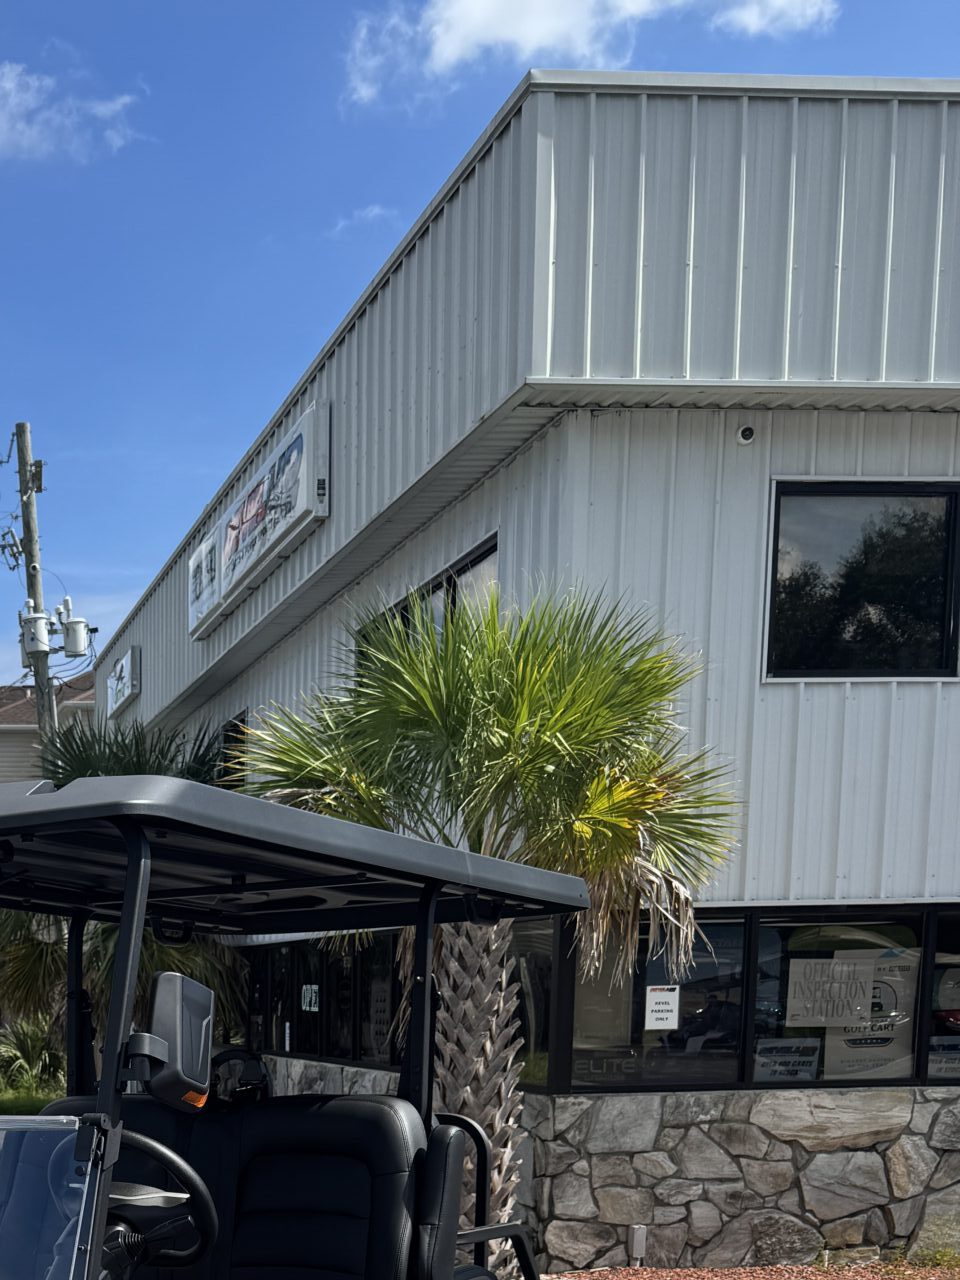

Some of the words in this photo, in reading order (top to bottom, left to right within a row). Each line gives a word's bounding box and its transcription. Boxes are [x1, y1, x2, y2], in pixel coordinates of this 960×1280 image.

[802, 961, 859, 981] OFFICIAL
[792, 980, 868, 999] INSPECTION
[802, 999, 854, 1018] STATION
[870, 1023, 895, 1032] CART
